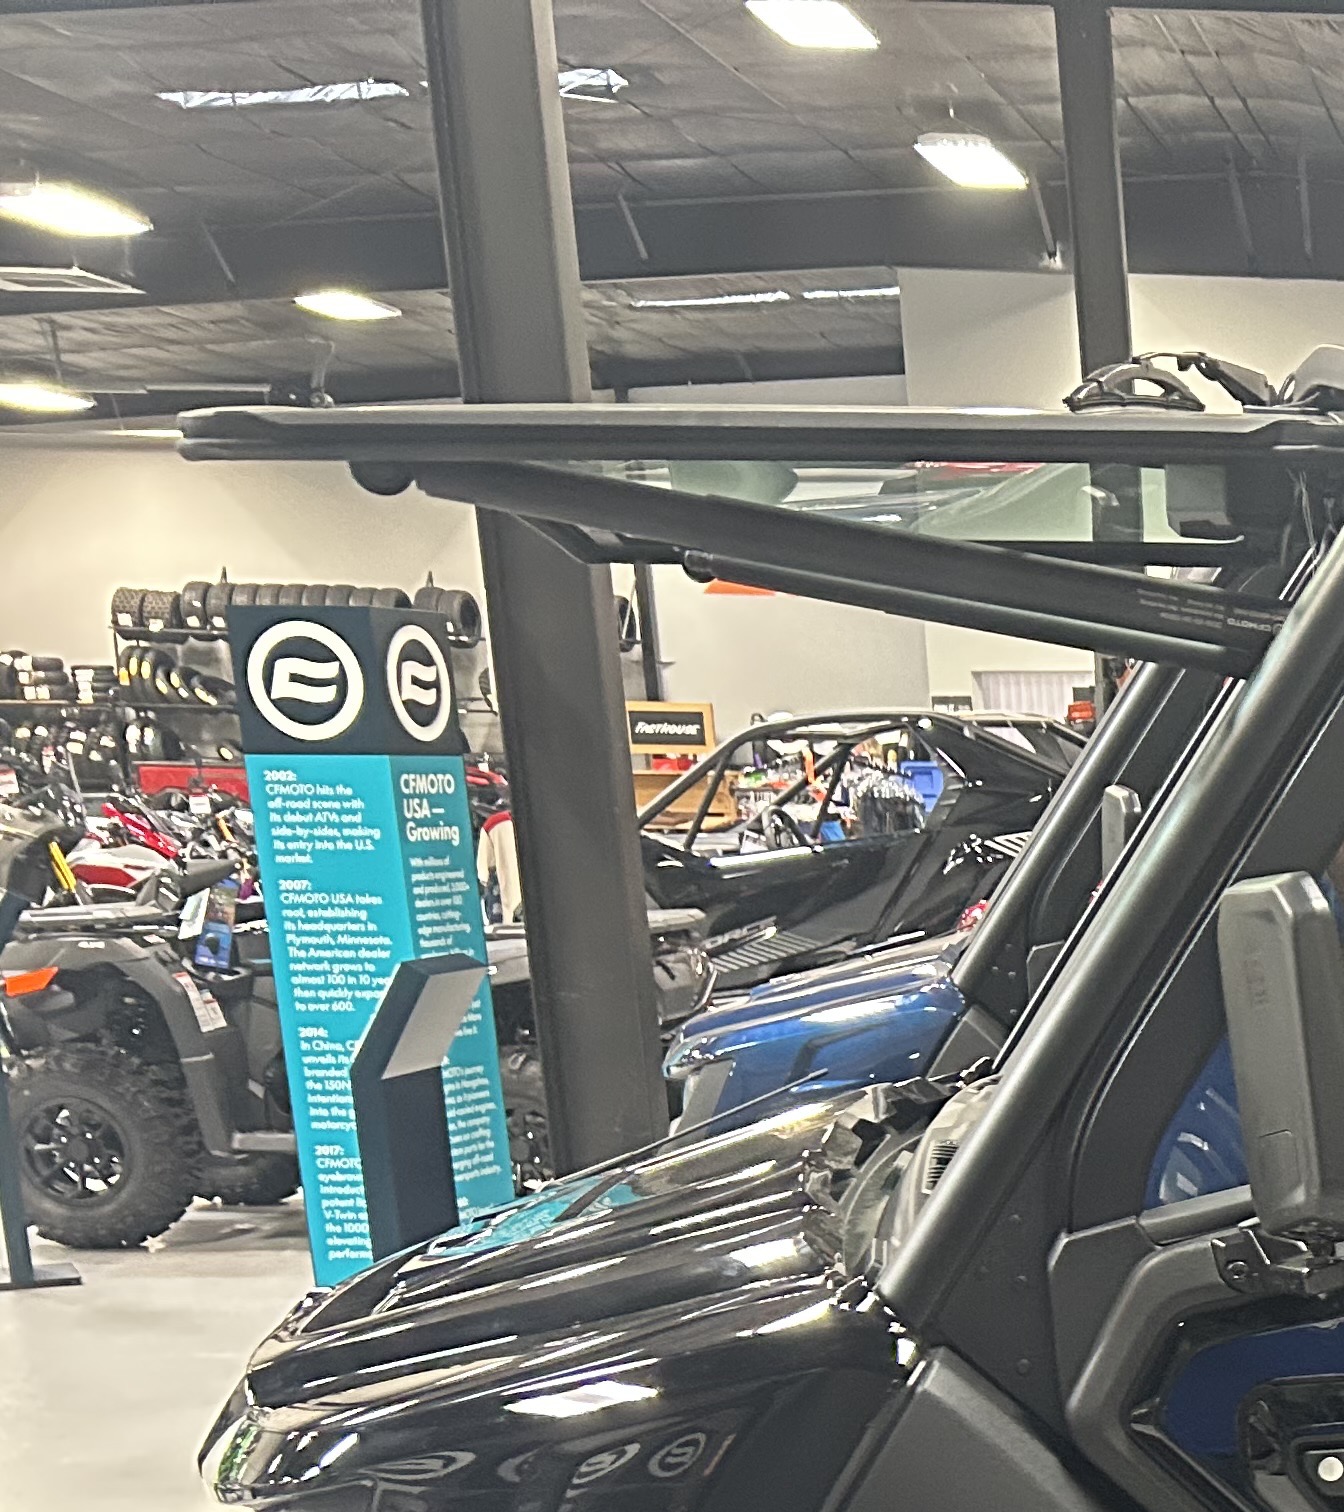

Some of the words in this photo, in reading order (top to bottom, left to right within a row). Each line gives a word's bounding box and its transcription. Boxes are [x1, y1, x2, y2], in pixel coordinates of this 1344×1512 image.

[266, 784, 315, 796] CFMOTO
[316, 784, 334, 795] hits
[336, 784, 353, 795] the
[400, 773, 456, 795] CFMOTO
[267, 797, 311, 809] off-road
[312, 800, 341, 809] scene
[342, 798, 364, 809] with
[283, 811, 313, 822] debut
[314, 812, 339, 822] ATVs
[341, 812, 362, 823] and
[342, 826, 381, 840] making
[406, 820, 461, 847] Growing
[286, 841, 314, 852] entry
[315, 840, 335, 850] into
[336, 840, 353, 850] the
[279, 880, 312, 890] 2007:
[280, 893, 329, 904] CFMOTO
[331, 894, 354, 904] USA
[356, 894, 383, 905] takes
[282, 908, 305, 918] root,
[307, 907, 368, 920] establishing
[298, 920, 365, 933] headquarters
[367, 921, 378, 931] in
[286, 934, 335, 946] Plymouth,
[337, 935, 393, 946] Minnesota.
[288, 947, 306, 958] The
[308, 948, 356, 958] American
[358, 948, 390, 958] dealer
[290, 960, 331, 971] network
[364, 962, 376, 972] to
[291, 974, 325, 985] almost
[327, 974, 345, 985] 100
[347, 975, 357, 985] in
[359, 974, 370, 985] 10
[294, 987, 316, 998] then
[318, 988, 353, 1000] quickly
[295, 1001, 306, 1011] to
[307, 1003, 330, 1012] over
[312, 1040, 345, 1052] China,
[302, 1054, 336, 1064] unveils
[304, 1066, 347, 1077] branded
[305, 1080, 323, 1090] the
[325, 1080, 352, 1090] 150N
[307, 1094, 354, 1104] intention
[331, 1106, 348, 1117] the
[344, 1223, 370, 1233] 1000
